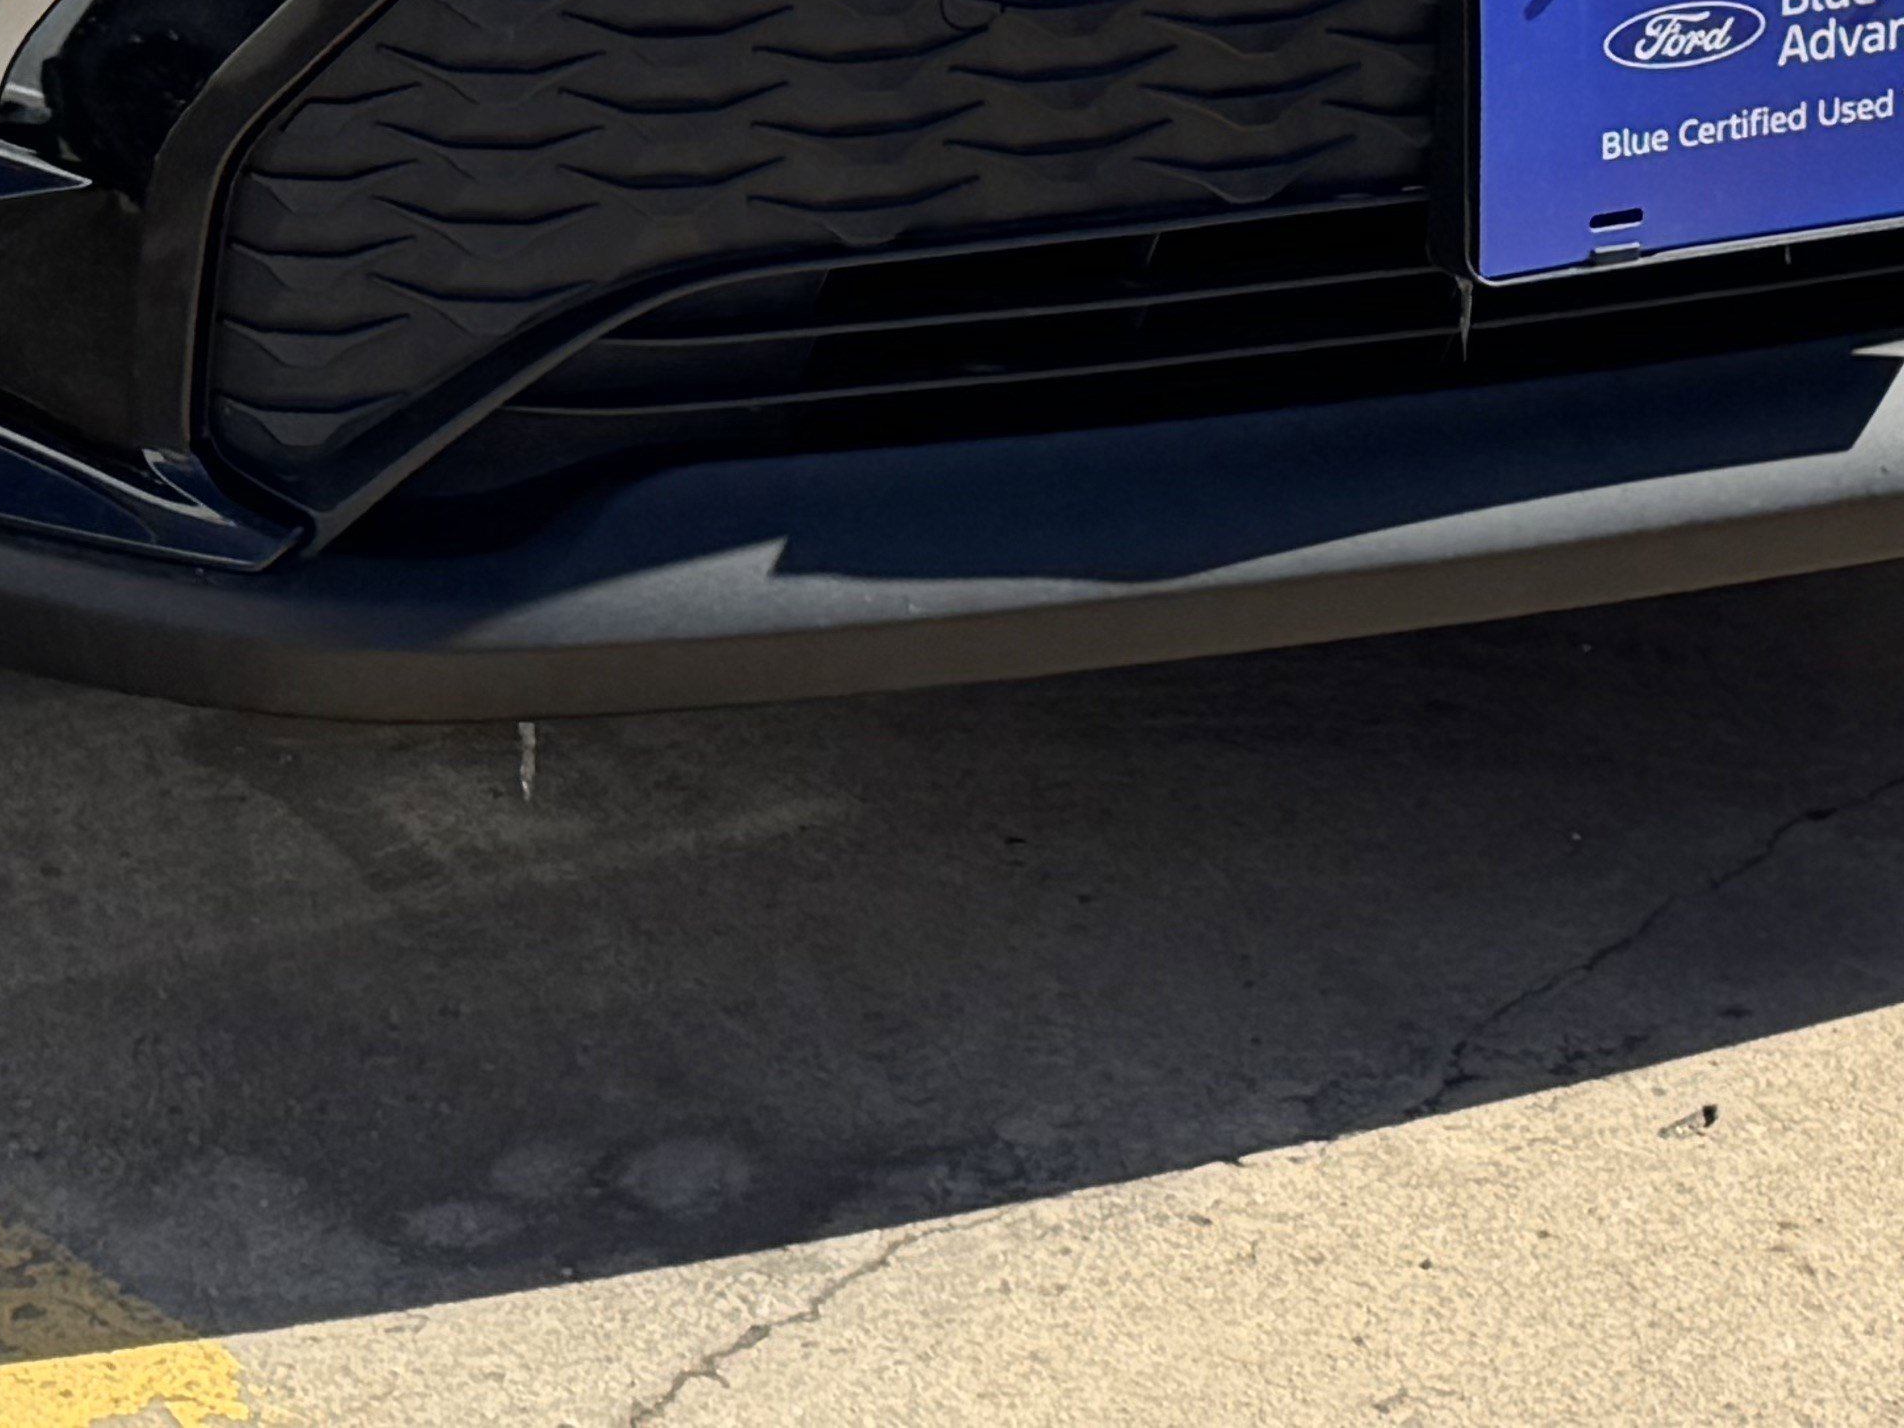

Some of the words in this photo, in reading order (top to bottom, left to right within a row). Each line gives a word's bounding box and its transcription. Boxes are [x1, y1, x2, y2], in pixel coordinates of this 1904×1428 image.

[1634, 2, 1734, 62] Ford
[1602, 127, 1669, 161] Blue
[1678, 106, 1808, 149] Certified
[1818, 89, 1894, 127] Used
